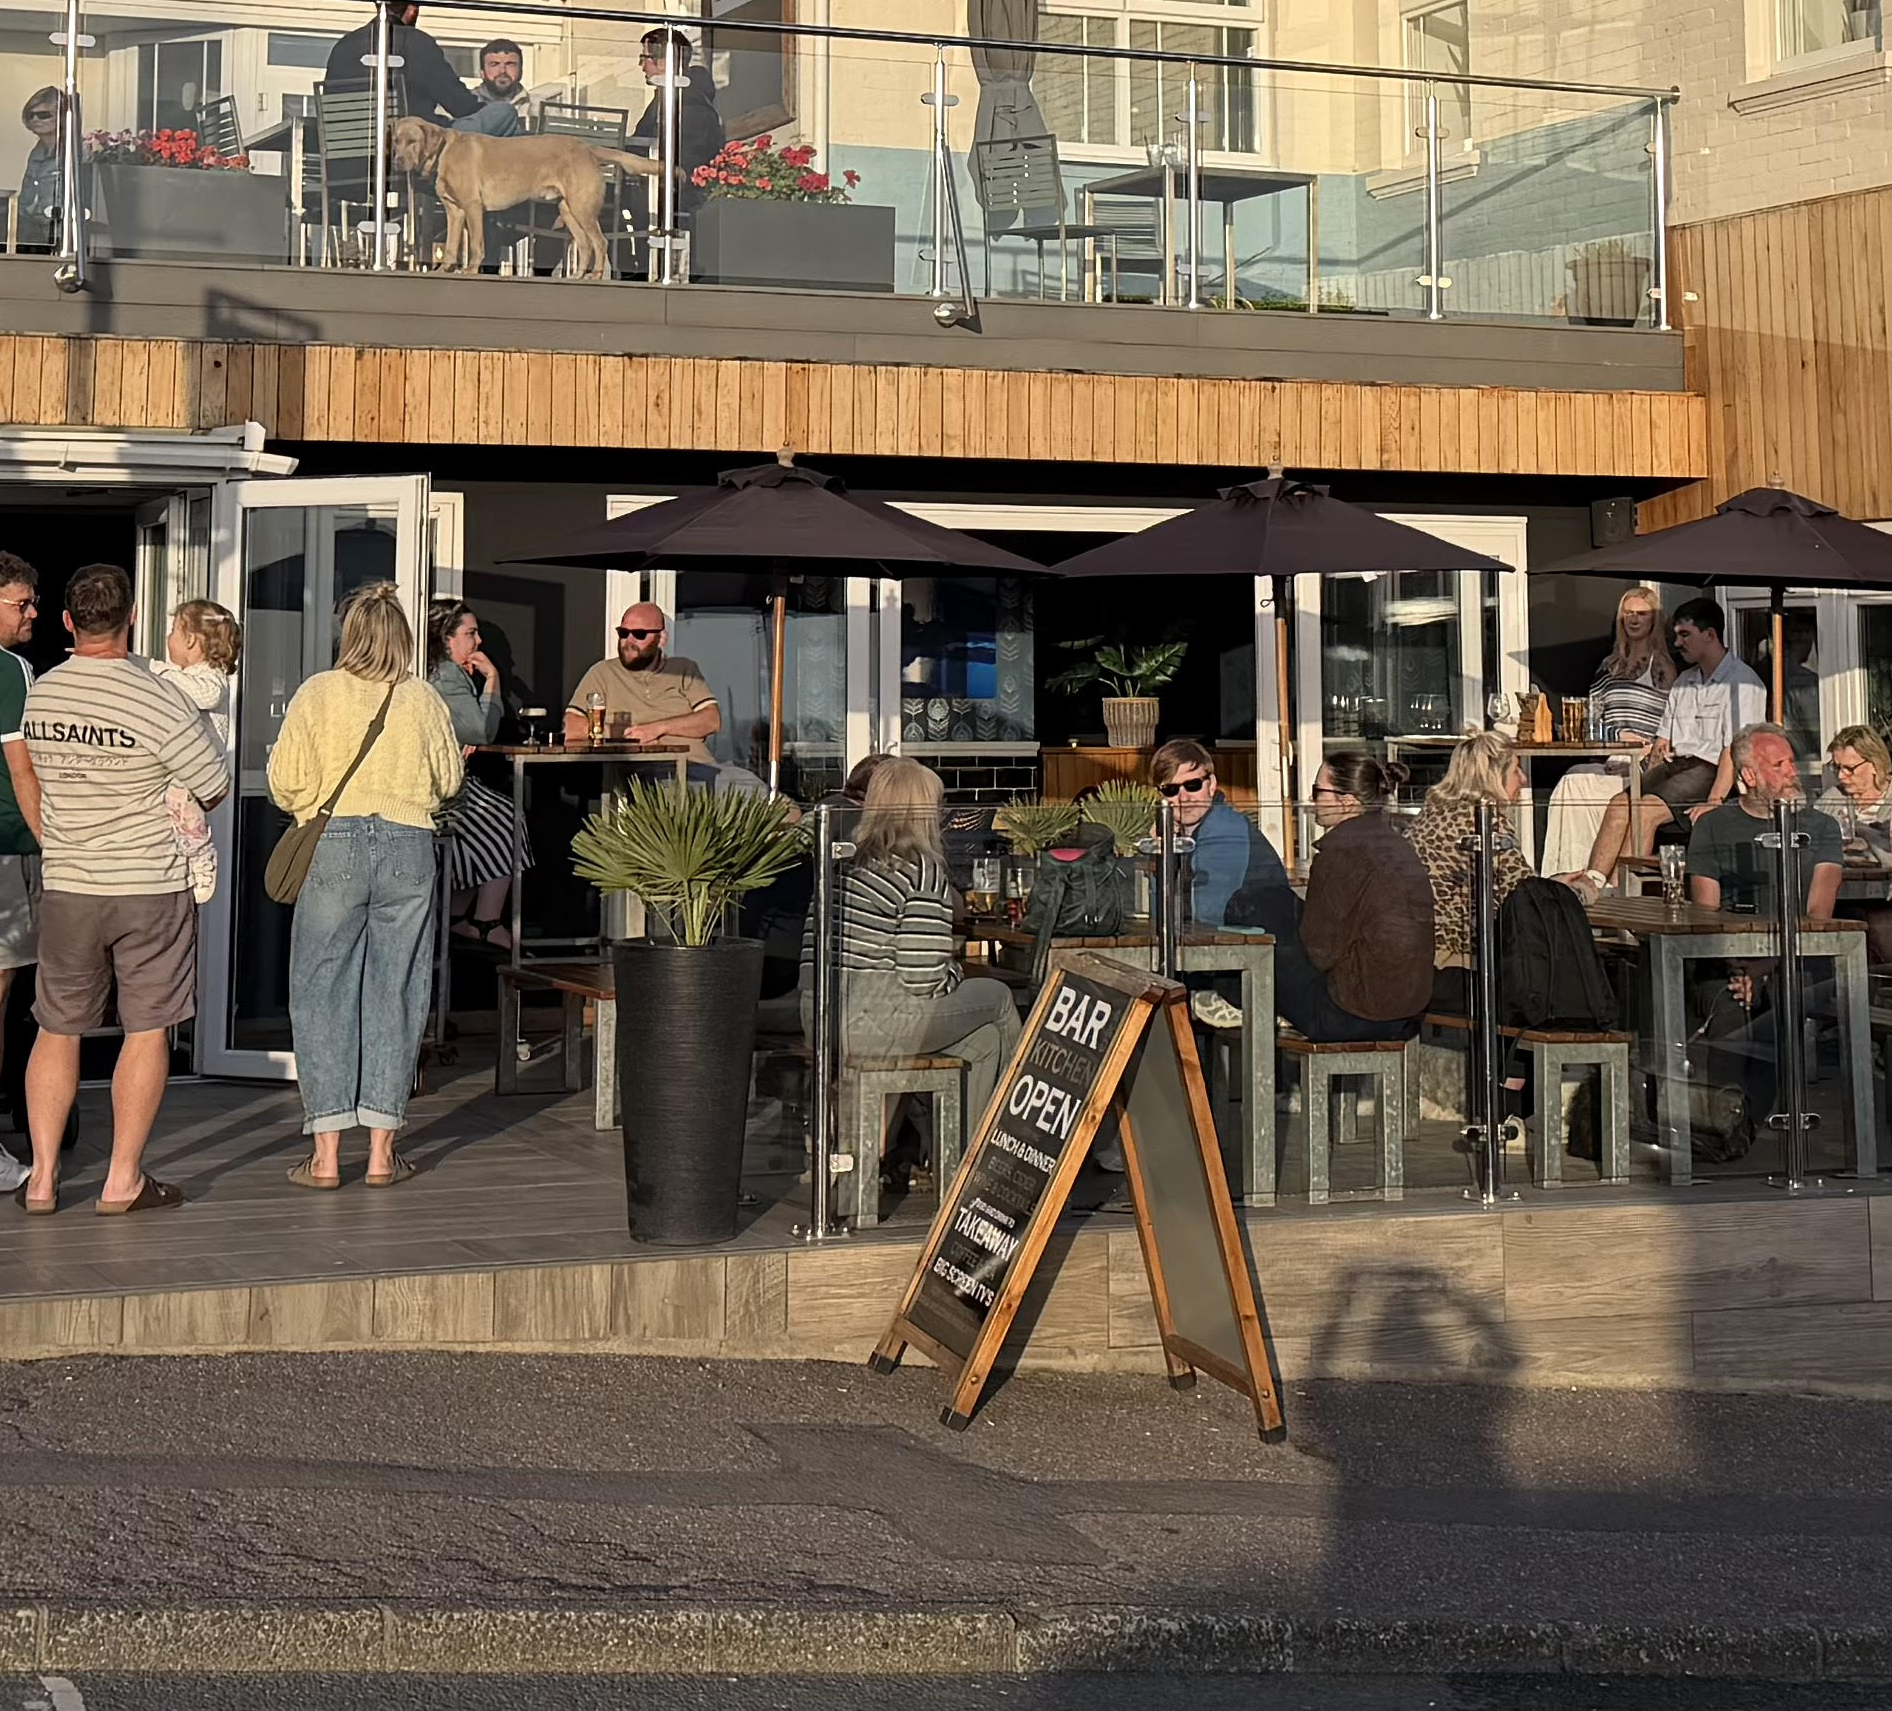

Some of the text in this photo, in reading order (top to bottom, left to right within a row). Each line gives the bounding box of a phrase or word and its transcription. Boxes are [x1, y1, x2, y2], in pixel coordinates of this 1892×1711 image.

[24, 721, 136, 748] ALLSAINTS
[1045, 986, 1112, 1049] BAR
[1030, 1039, 1097, 1087] KITCHEN
[1009, 1075, 1081, 1140] OPEN
[990, 1128, 1018, 1156] LUNCH
[954, 1207, 1019, 1262] TAKEAWAY
